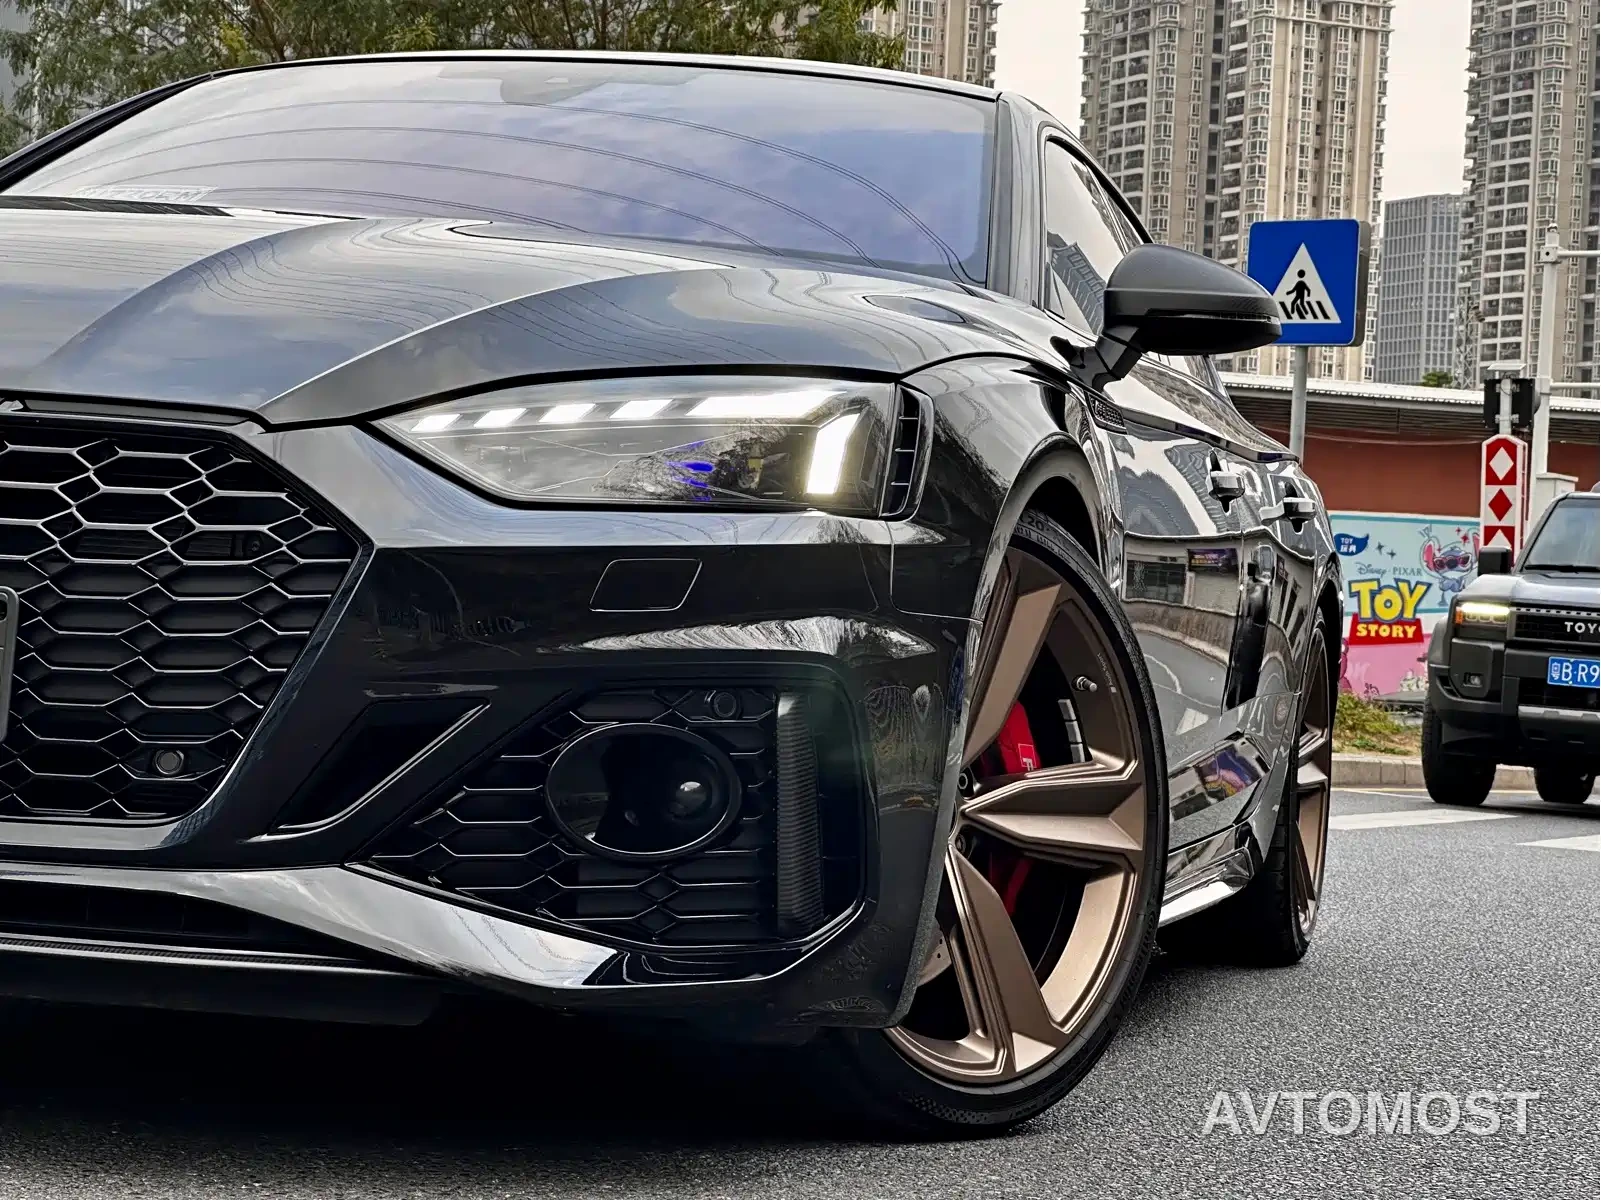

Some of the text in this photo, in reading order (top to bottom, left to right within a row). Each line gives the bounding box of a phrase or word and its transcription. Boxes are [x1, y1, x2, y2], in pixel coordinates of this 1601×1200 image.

[1354, 561, 1423, 578] Disney PIXAR
[1348, 578, 1431, 622] TOY
[1356, 624, 1417, 638] STORY
[1564, 621, 1600, 634] TOY
